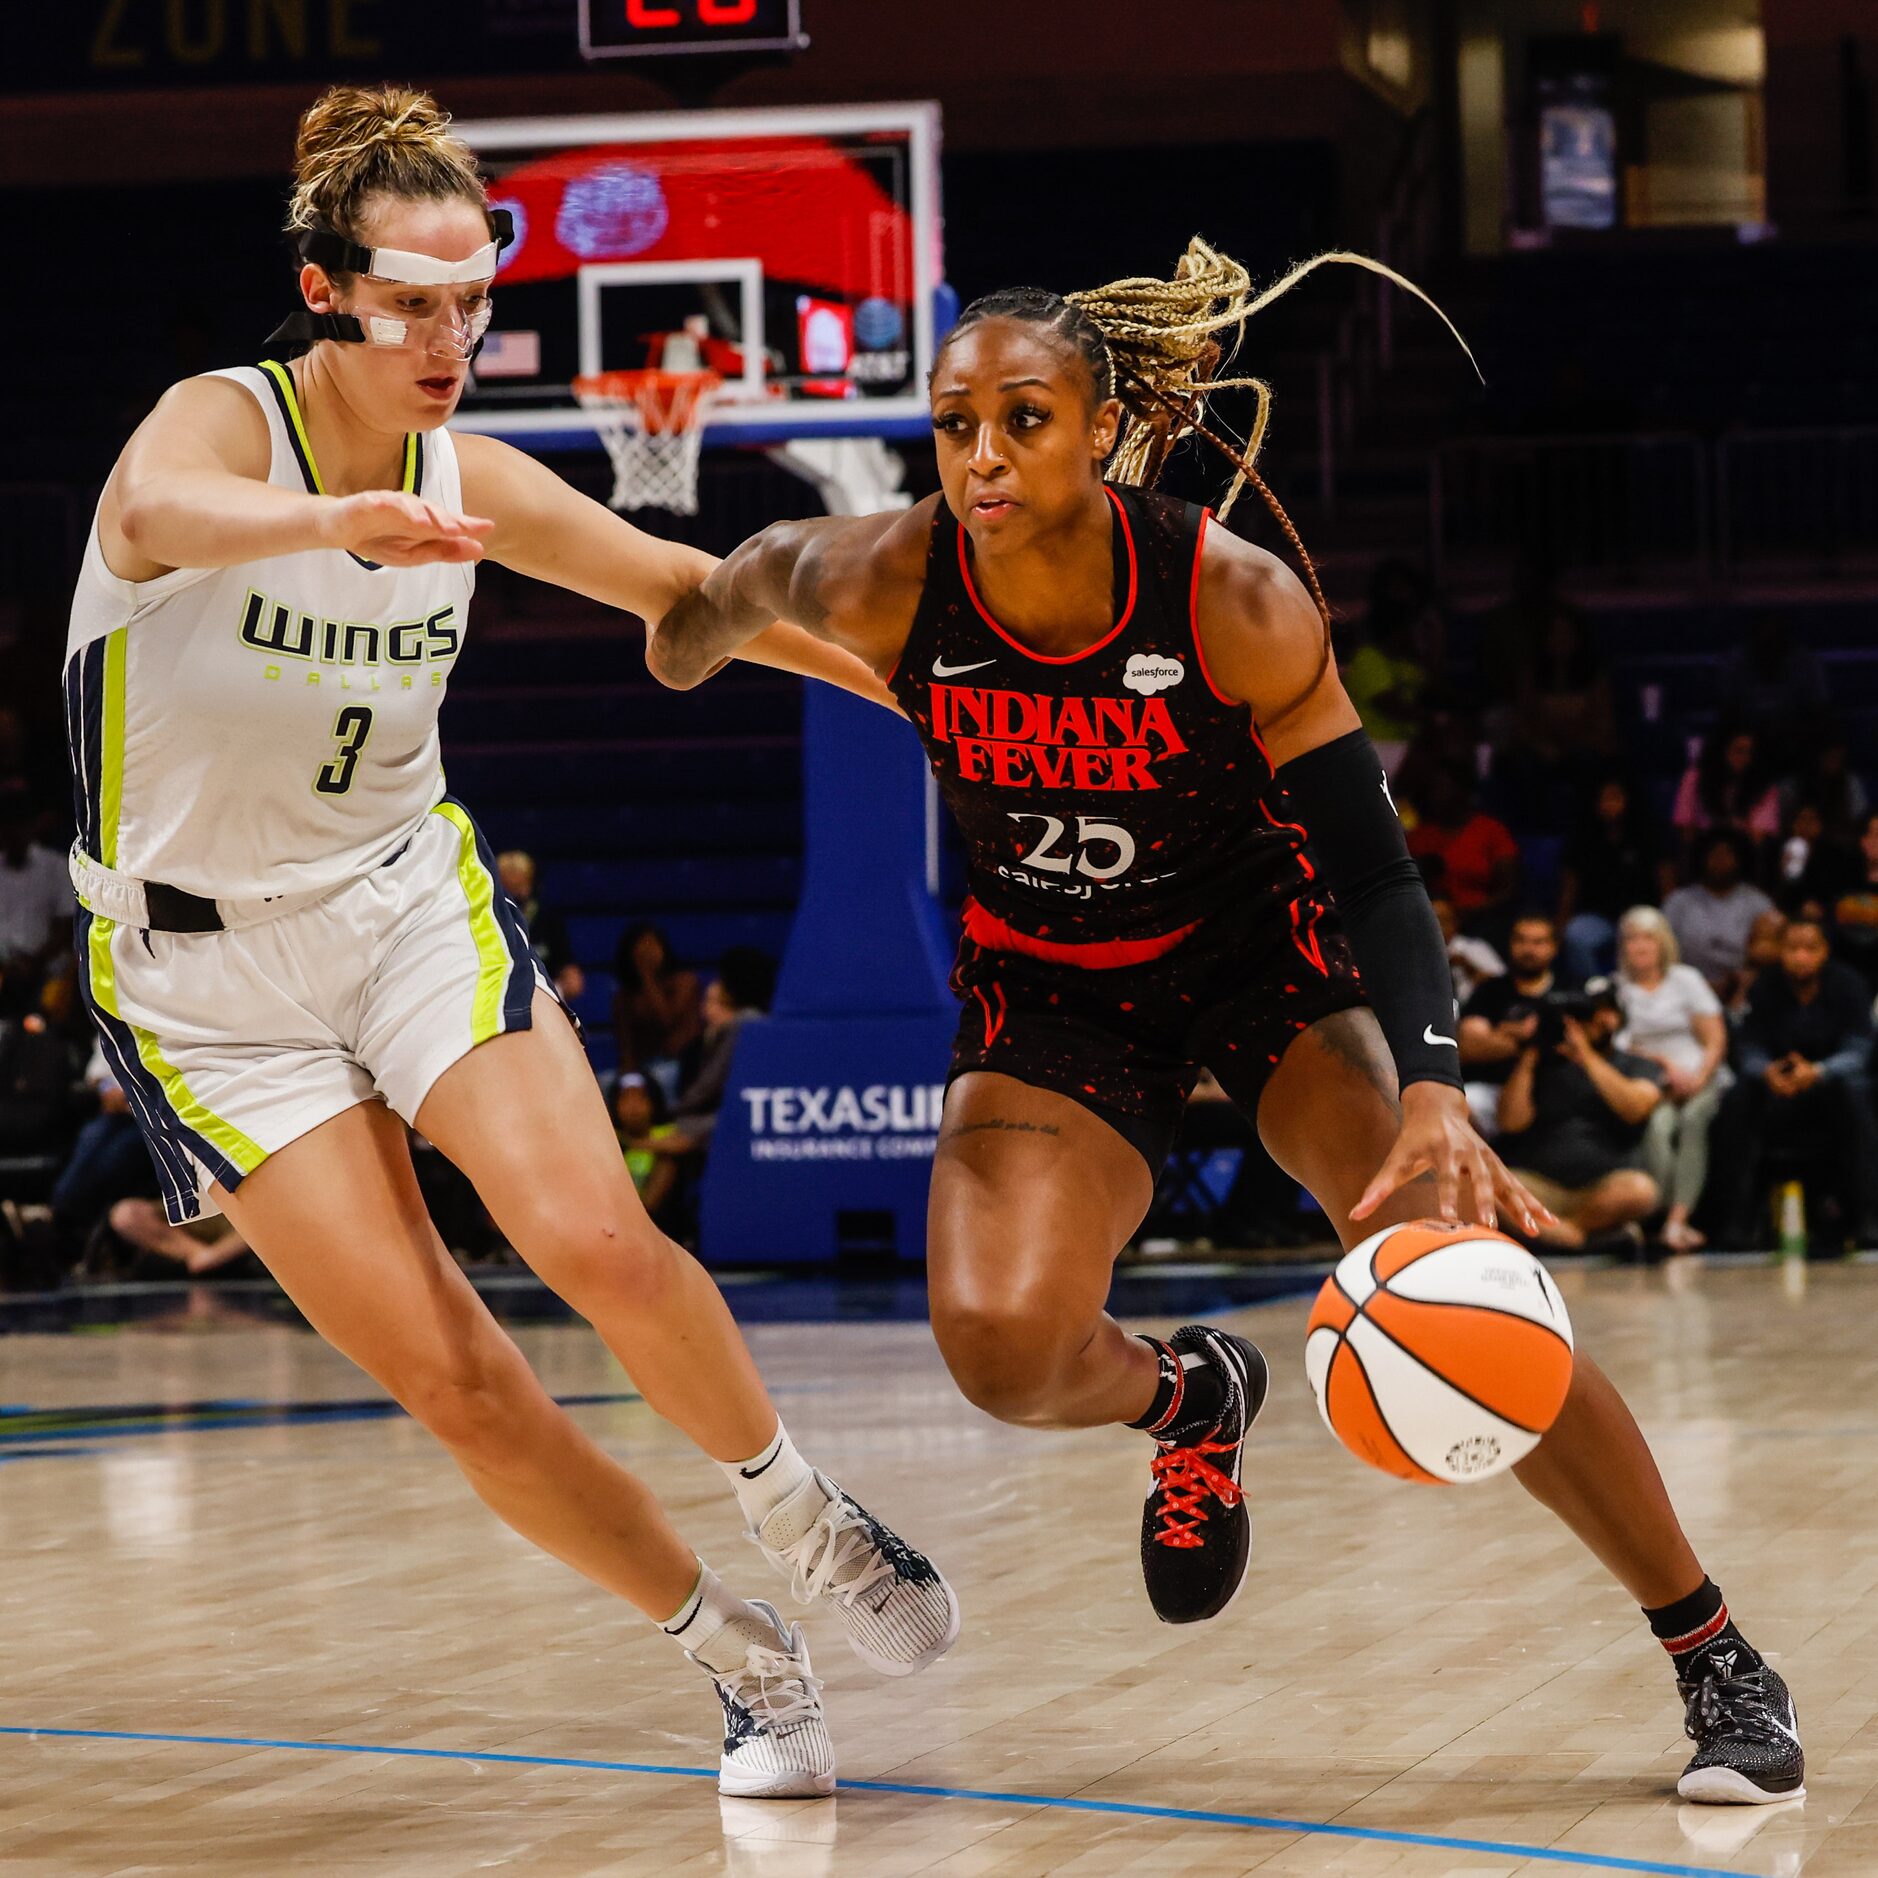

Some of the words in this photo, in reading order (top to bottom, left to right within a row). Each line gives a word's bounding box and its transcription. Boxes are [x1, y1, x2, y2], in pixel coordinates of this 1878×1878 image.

[237, 585, 460, 666] WINGS
[263, 664, 442, 690] DALLAS
[1131, 667, 1179, 679] salesforce
[311, 701, 375, 798] 3
[927, 682, 1190, 762] INDIANA
[953, 735, 1162, 792] FEVER
[1006, 812, 1136, 880] 25
